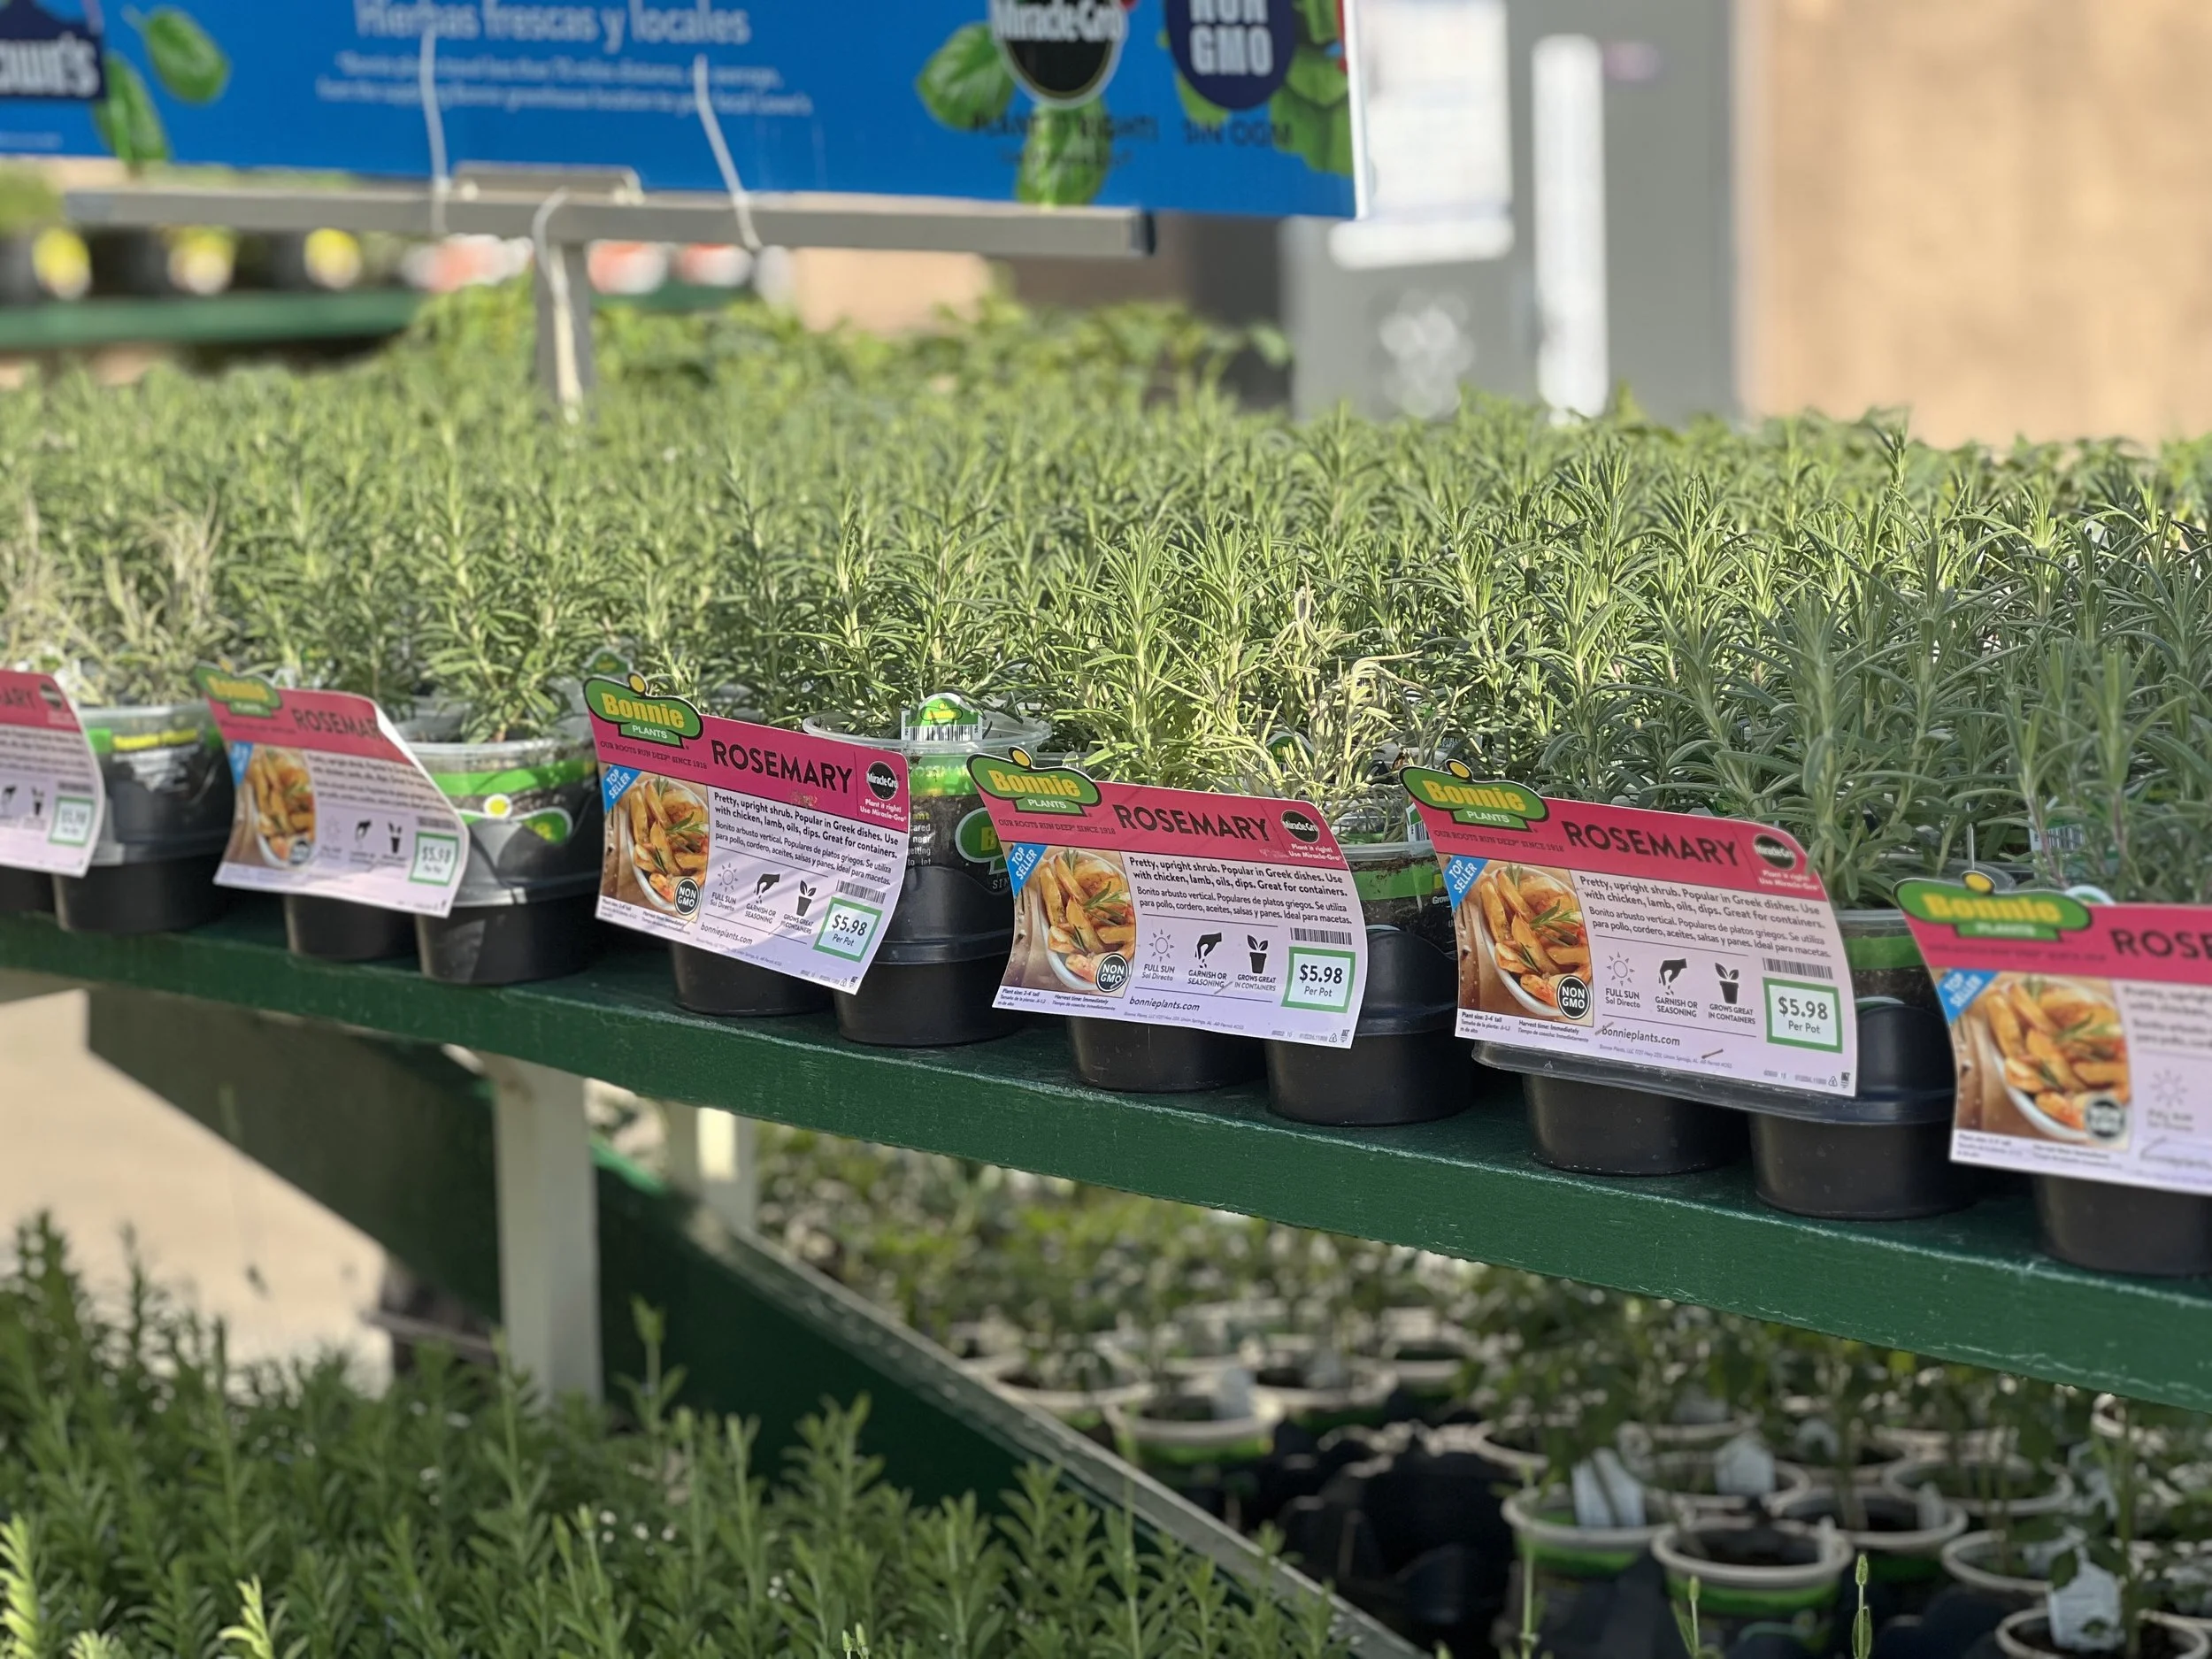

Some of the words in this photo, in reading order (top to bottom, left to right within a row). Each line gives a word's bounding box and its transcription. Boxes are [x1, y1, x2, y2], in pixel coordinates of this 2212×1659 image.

[483, 0, 599, 41] frescas
[601, 7, 626, 54] y
[628, 0, 751, 44] locales
[1188, 25, 1274, 77] GMO
[601, 693, 684, 728] Bonnie
[633, 725, 668, 739] PLANTS
[710, 739, 853, 794] ROSEMARY
[606, 769, 619, 786] TOP
[987, 770, 1081, 796] Bonnie
[609, 772, 631, 800] SELLER
[1422, 780, 1526, 811] Bonnie
[1027, 799, 1066, 809] PLANTS
[715, 792, 740, 807] Pretty,
[741, 801, 768, 813] upright
[770, 806, 793, 818] shrub.
[795, 811, 822, 826] Popular
[825, 818, 832, 828] in
[833, 821, 856, 834] Greek
[857, 827, 882, 841] dishes.
[885, 834, 899, 845] Use
[1112, 804, 1270, 841] ROSEMARY
[1467, 810, 1510, 822] PLANTS
[715, 806, 731, 816] with
[733, 810, 763, 826] chicken,
[764, 816, 785, 831] lamb,
[787, 823, 801, 835] oils,
[803, 826, 820, 839] dips.
[823, 833, 843, 844] Great
[845, 837, 856, 847] for
[857, 841, 897, 858] containers.
[1561, 820, 1739, 866] ROSEMARY
[1011, 847, 1025, 864] TOP
[1015, 849, 1038, 879] SELLER
[1129, 856, 1158, 868] Pretty,
[1160, 861, 1191, 872] upright
[1194, 863, 1220, 873] shrub.
[1222, 864, 1253, 877] Popular
[1266, 869, 1292, 879] Greek
[1294, 871, 1324, 882] dishes.
[1325, 873, 1342, 883] Use
[1448, 860, 1464, 878] TOP
[1154, 872, 1189, 885] chicken,
[1190, 874, 1214, 887] lamb,
[1216, 878, 1234, 888] oils,
[1235, 879, 1256, 890] dips.
[1258, 880, 1281, 891] Great
[1284, 883, 1296, 892] for
[1299, 886, 1348, 896] containers.
[1454, 862, 1478, 894] SELLER
[679, 886, 696, 899] NON
[712, 892, 725, 902] FULL
[725, 895, 736, 904] SUN
[1137, 887, 1160, 895] Bonito
[1161, 887, 1187, 898] arbusto
[1188, 891, 1216, 901] vertical.
[1217, 893, 1251, 905] Populares
[1263, 897, 1284, 907] platos
[1286, 901, 1314, 910] griegos.
[1325, 902, 1347, 912] utiliza
[1579, 875, 1612, 891] Pretty,
[1614, 882, 1649, 894] upright
[1650, 886, 1681, 897] shrub.
[1682, 888, 1718, 902] Popular
[1722, 894, 1730, 902] in
[1732, 895, 1763, 907] Greek
[1764, 899, 1799, 912] dishes.
[1800, 903, 1820, 915] Use
[677, 896, 695, 907] GMO
[746, 903, 768, 914] GARNISH
[1921, 892, 2062, 923] Bonnie
[745, 910, 772, 924] SEASONING
[1584, 891, 1605, 901] with
[1607, 892, 1647, 907] chicken,
[1647, 897, 1675, 911] lamb,
[1677, 902, 1697, 915] oils,
[1698, 904, 1721, 917] dips.
[1724, 907, 1751, 918] Great
[1753, 910, 1767, 921] for
[1770, 914, 1825, 929] containers.
[784, 913, 799, 923] GROWS
[800, 918, 814, 926] GREAT
[832, 914, 867, 936] $5.98
[700, 922, 753, 945] bonnieplants.com
[786, 922, 811, 934] CONTAINERS
[833, 934, 843, 943] Per
[843, 936, 854, 947] Pot
[1102, 964, 1125, 974] NON
[1144, 964, 1160, 972] FULL
[1188, 970, 1217, 979] GARNISH
[1299, 964, 1343, 984] $5.98
[1101, 973, 1122, 983] GMO
[1187, 979, 1225, 988] SEASONING
[1239, 982, 1276, 991] CONTAINERS
[1304, 986, 1317, 995] Per
[1318, 987, 1333, 997] Pot
[1562, 987, 1585, 998] NON
[1605, 988, 1623, 998] FULL
[1624, 991, 1640, 1000] SUN
[1949, 978, 1984, 1010] SELLER
[1129, 995, 1200, 1011] bonnieplants.com
[1562, 997, 1585, 1010] GMO
[1617, 999, 1640, 1008] Directo
[1655, 996, 1686, 1008] GARNISH
[1687, 1000, 1698, 1010] OR
[1709, 1003, 1732, 1014] GROWS
[1734, 1007, 1754, 1016] GREAT
[1778, 996, 1828, 1020] $5.98
[1656, 1005, 1697, 1018] SEASONING
[1716, 1012, 1755, 1025] CONTAINERS
[1601, 1023, 1680, 1048] bonnieplants.com
[1788, 1021, 1803, 1032] Per
[1805, 1023, 1821, 1034] Pot
